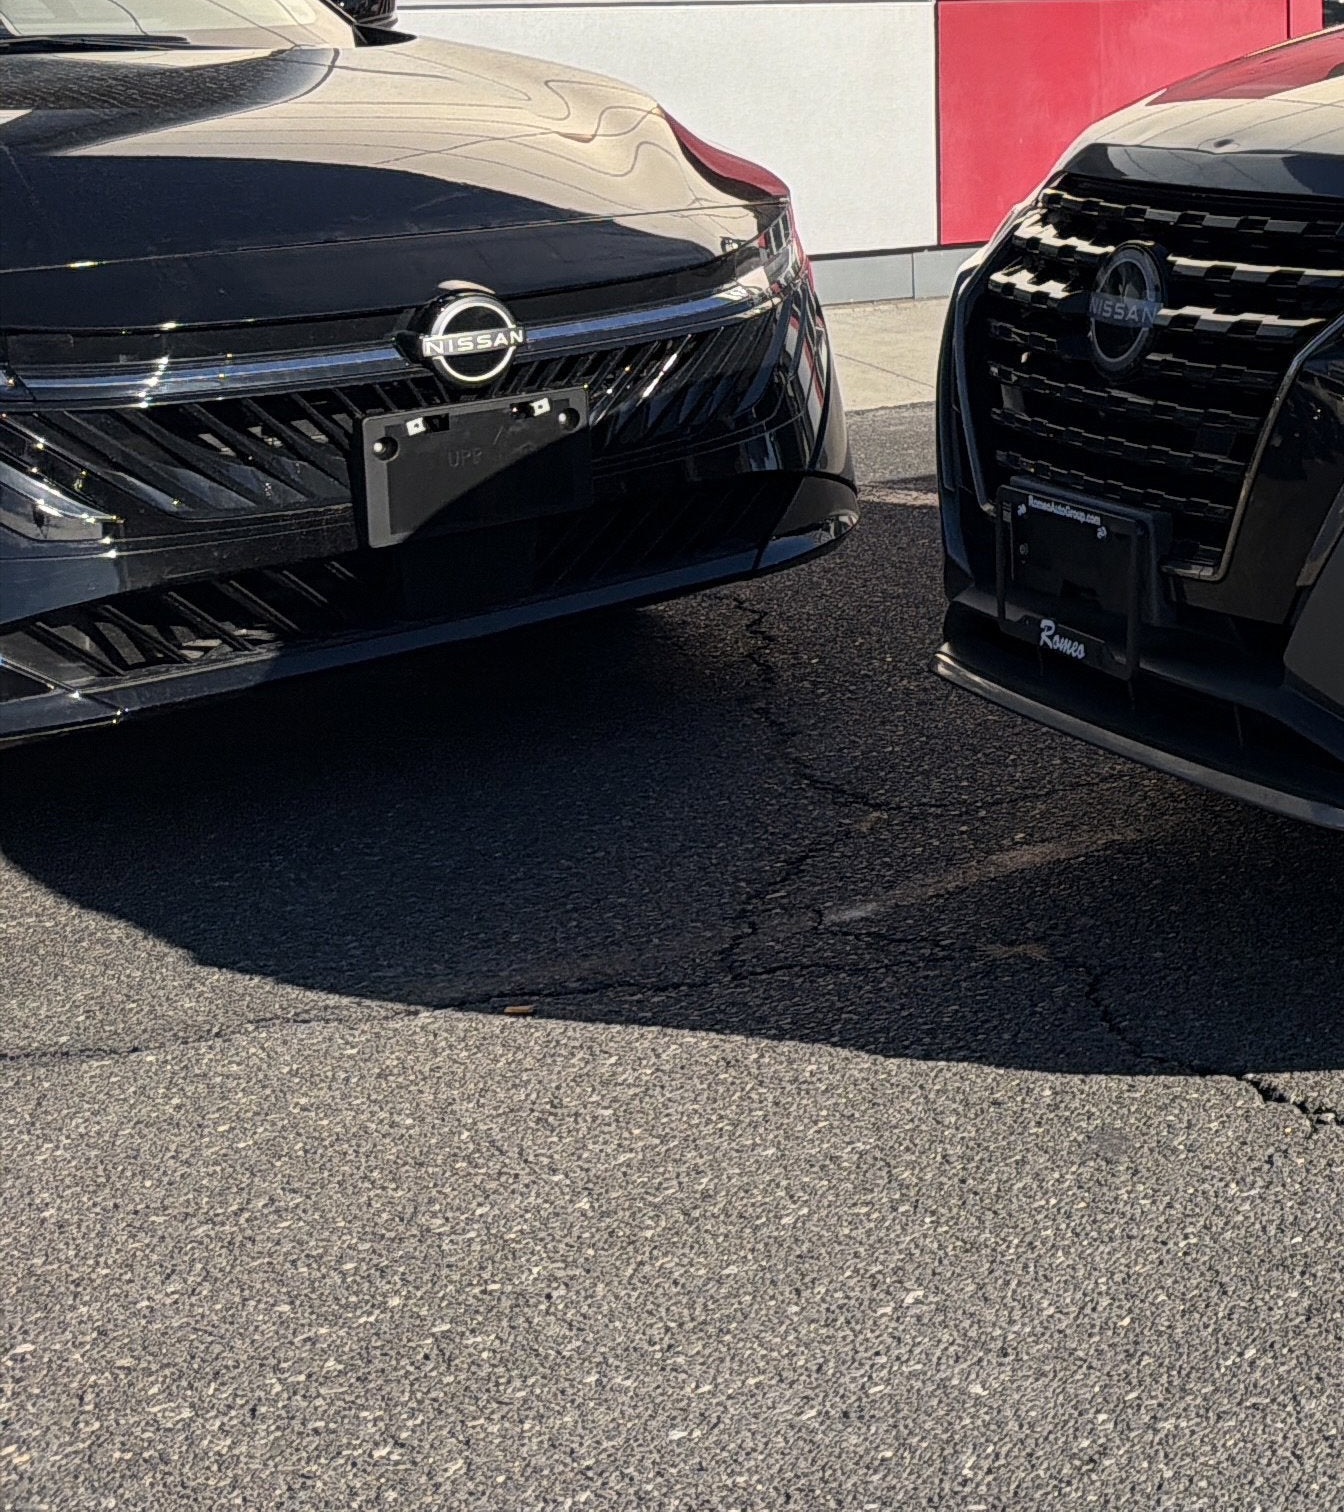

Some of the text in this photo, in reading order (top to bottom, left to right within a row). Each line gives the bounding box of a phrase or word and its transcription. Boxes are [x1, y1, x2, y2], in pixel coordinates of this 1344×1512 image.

[1089, 295, 1157, 323] NISSAN
[424, 329, 525, 355] NISSAN
[1040, 619, 1085, 659] Romeo
